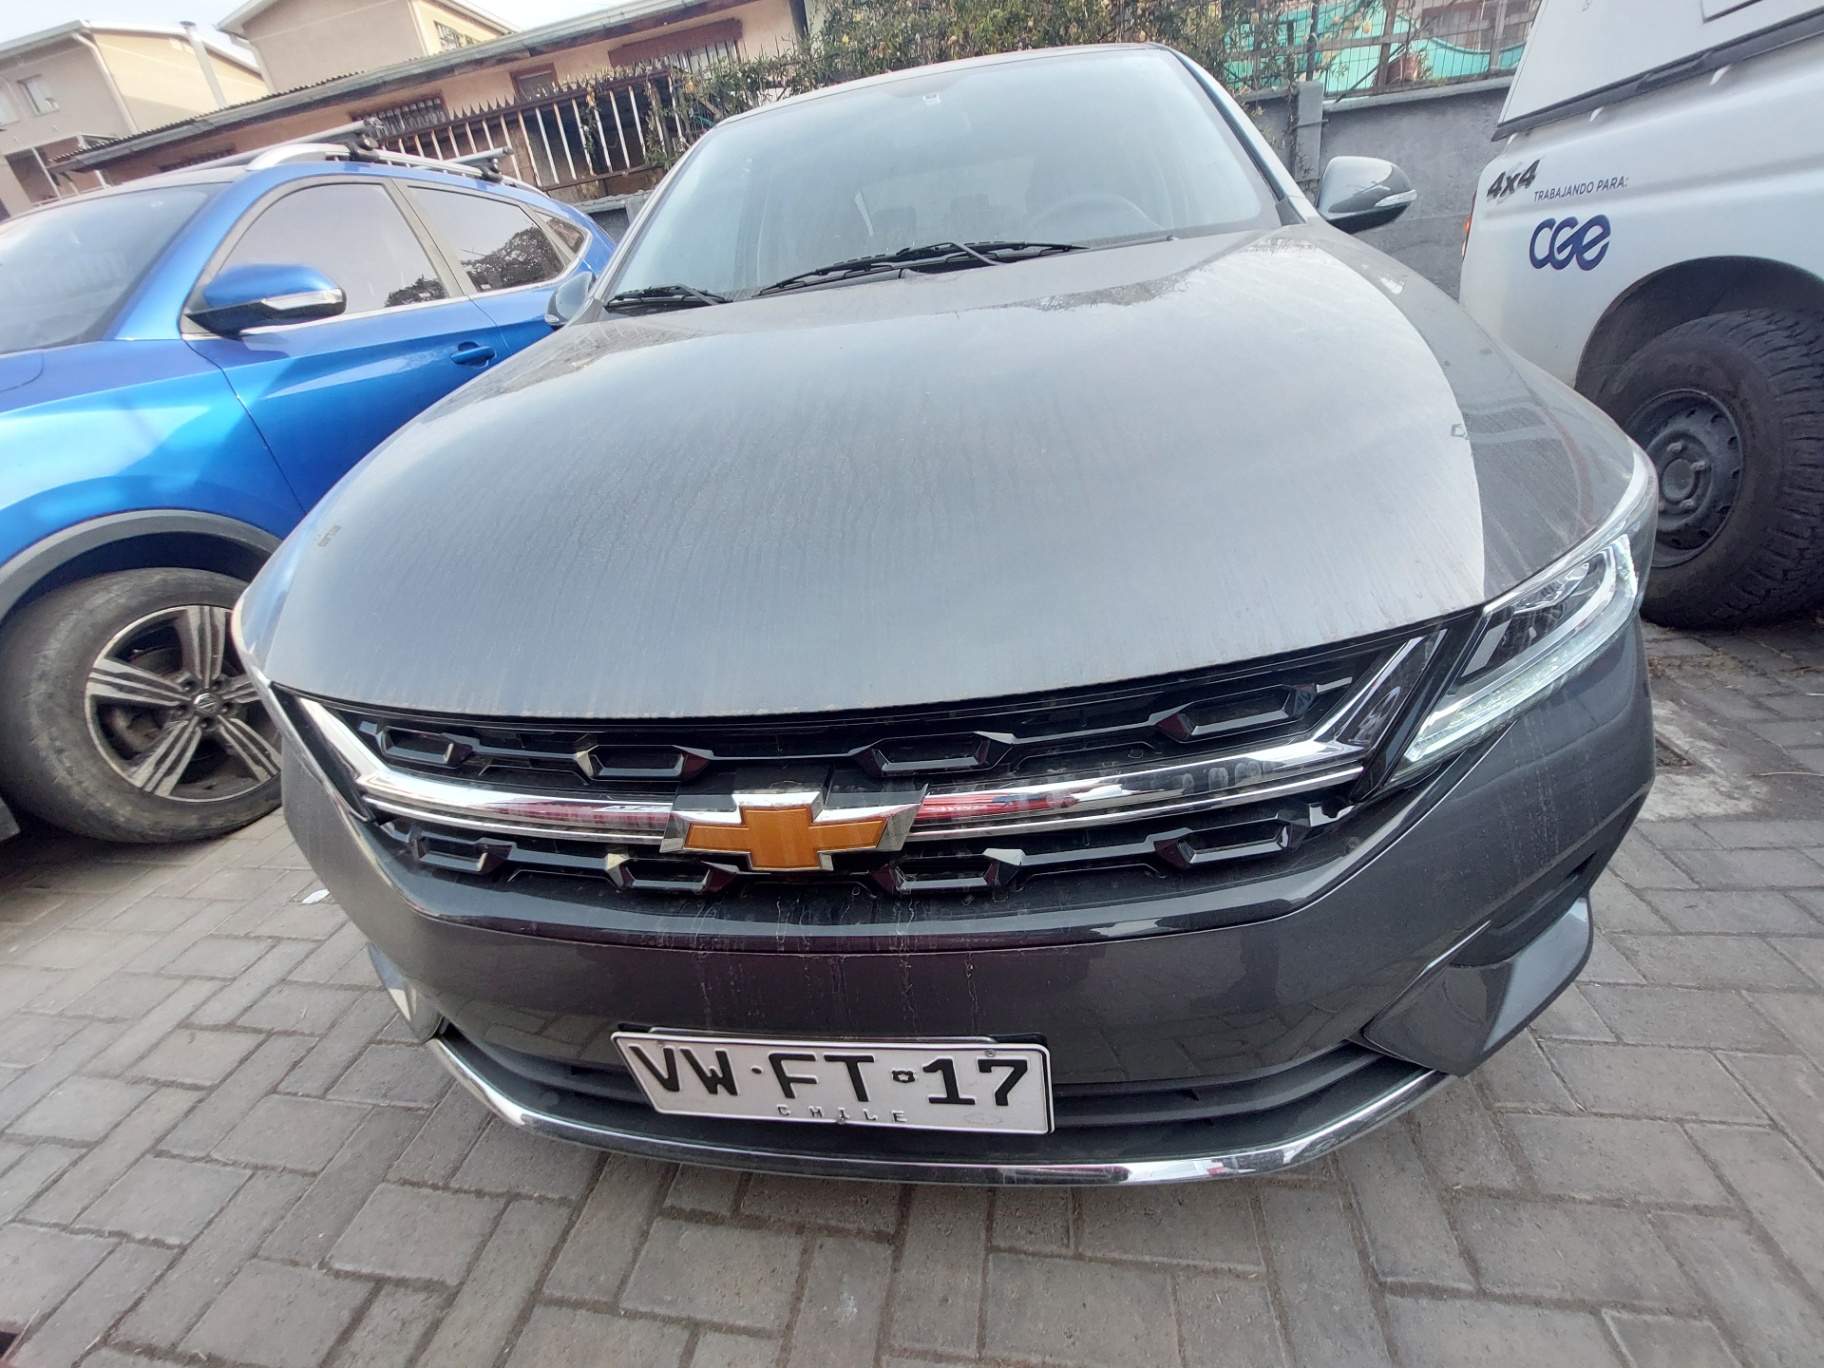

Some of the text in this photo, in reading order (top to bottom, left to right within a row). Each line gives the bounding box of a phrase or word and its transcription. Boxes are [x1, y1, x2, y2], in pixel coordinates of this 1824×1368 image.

[1486, 159, 1540, 200] 4x4
[1534, 182, 1594, 201] TRABAJANDO
[776, 1103, 907, 1123] CHILE
